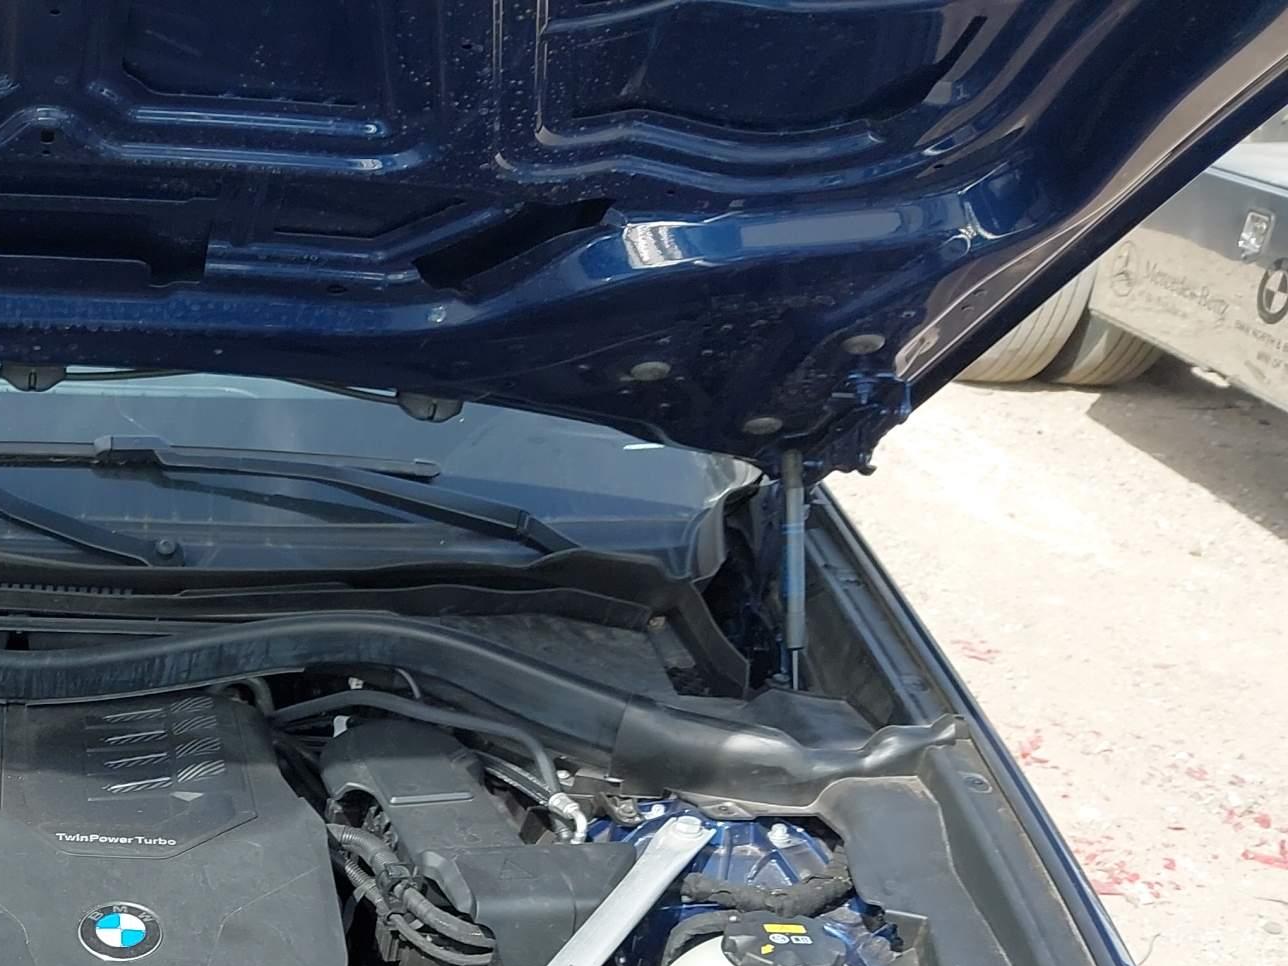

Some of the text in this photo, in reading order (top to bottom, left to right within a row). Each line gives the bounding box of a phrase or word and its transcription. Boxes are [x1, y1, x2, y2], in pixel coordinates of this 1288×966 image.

[55, 831, 178, 847] TwinPower Turbo
[89, 903, 155, 923] BMW
